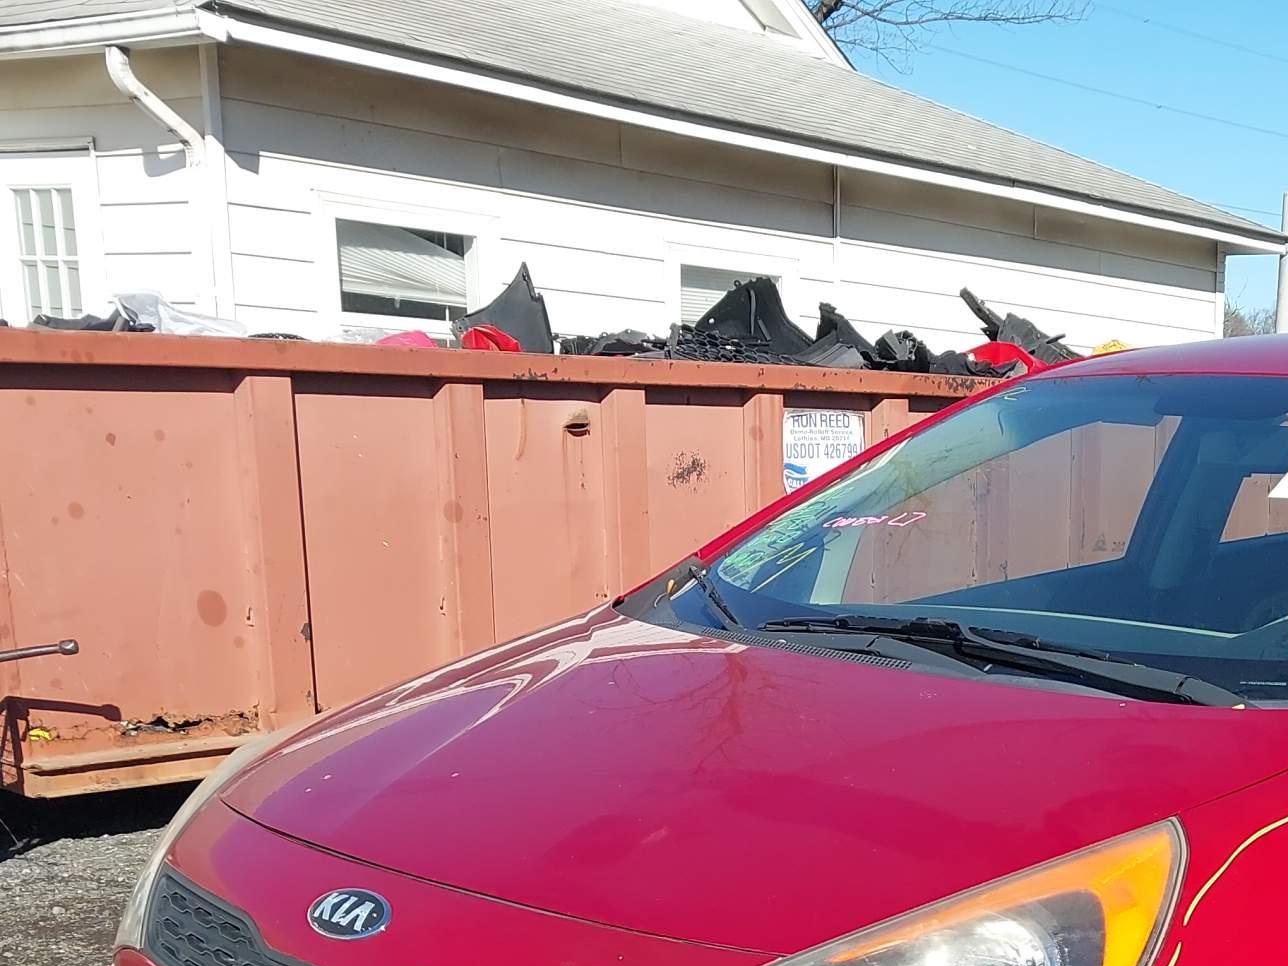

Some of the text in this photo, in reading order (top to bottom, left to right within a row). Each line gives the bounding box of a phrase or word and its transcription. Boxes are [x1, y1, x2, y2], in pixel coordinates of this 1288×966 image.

[792, 413, 850, 428] RON REED
[785, 443, 858, 459] USDOT 426799
[313, 892, 375, 932] KIA
